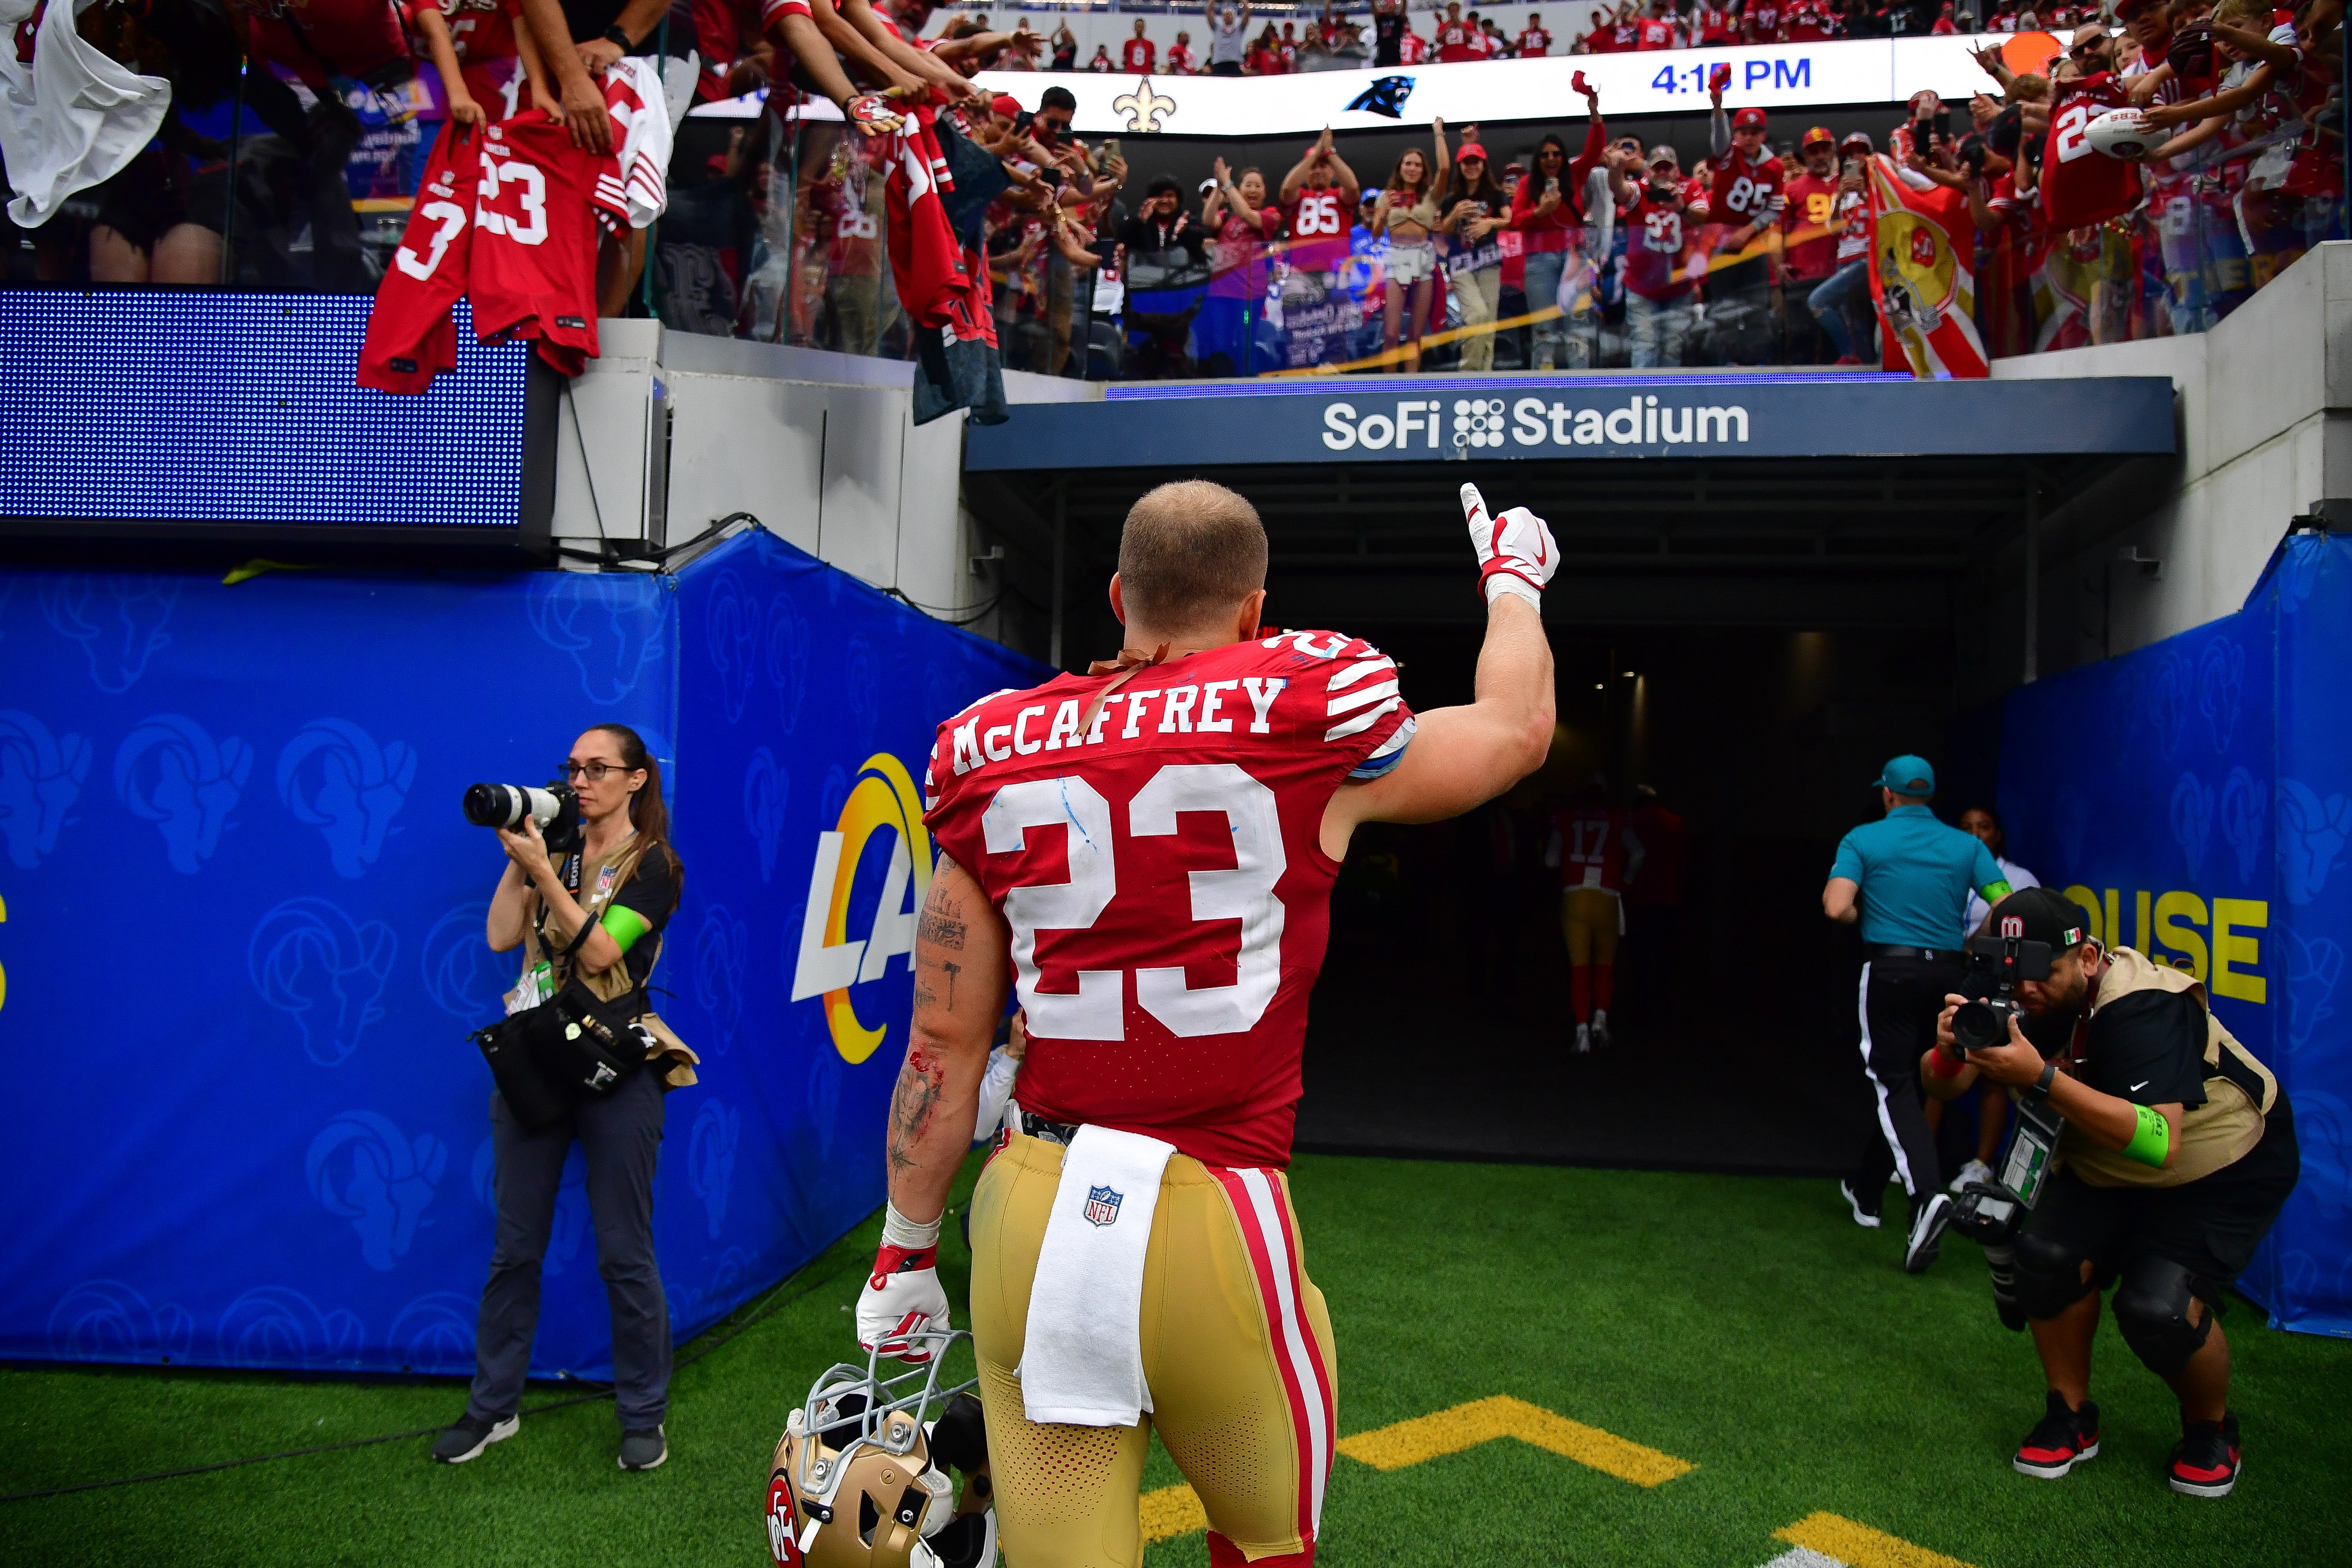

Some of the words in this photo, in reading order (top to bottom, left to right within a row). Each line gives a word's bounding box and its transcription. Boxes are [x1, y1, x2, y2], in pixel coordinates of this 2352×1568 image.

[1745, 58, 1810, 90] PM
[1296, 197, 1340, 235] 85
[1726, 176, 1772, 216] 85
[1323, 399, 1442, 451] SoFi
[1512, 395, 1750, 446] Stadium
[952, 678, 1286, 776] McCAFFREY
[1570, 819, 1610, 863] 17
[569, 854, 581, 887] SONY
[982, 763, 1287, 1041] 23
[1087, 1200, 1114, 1223] NFL
